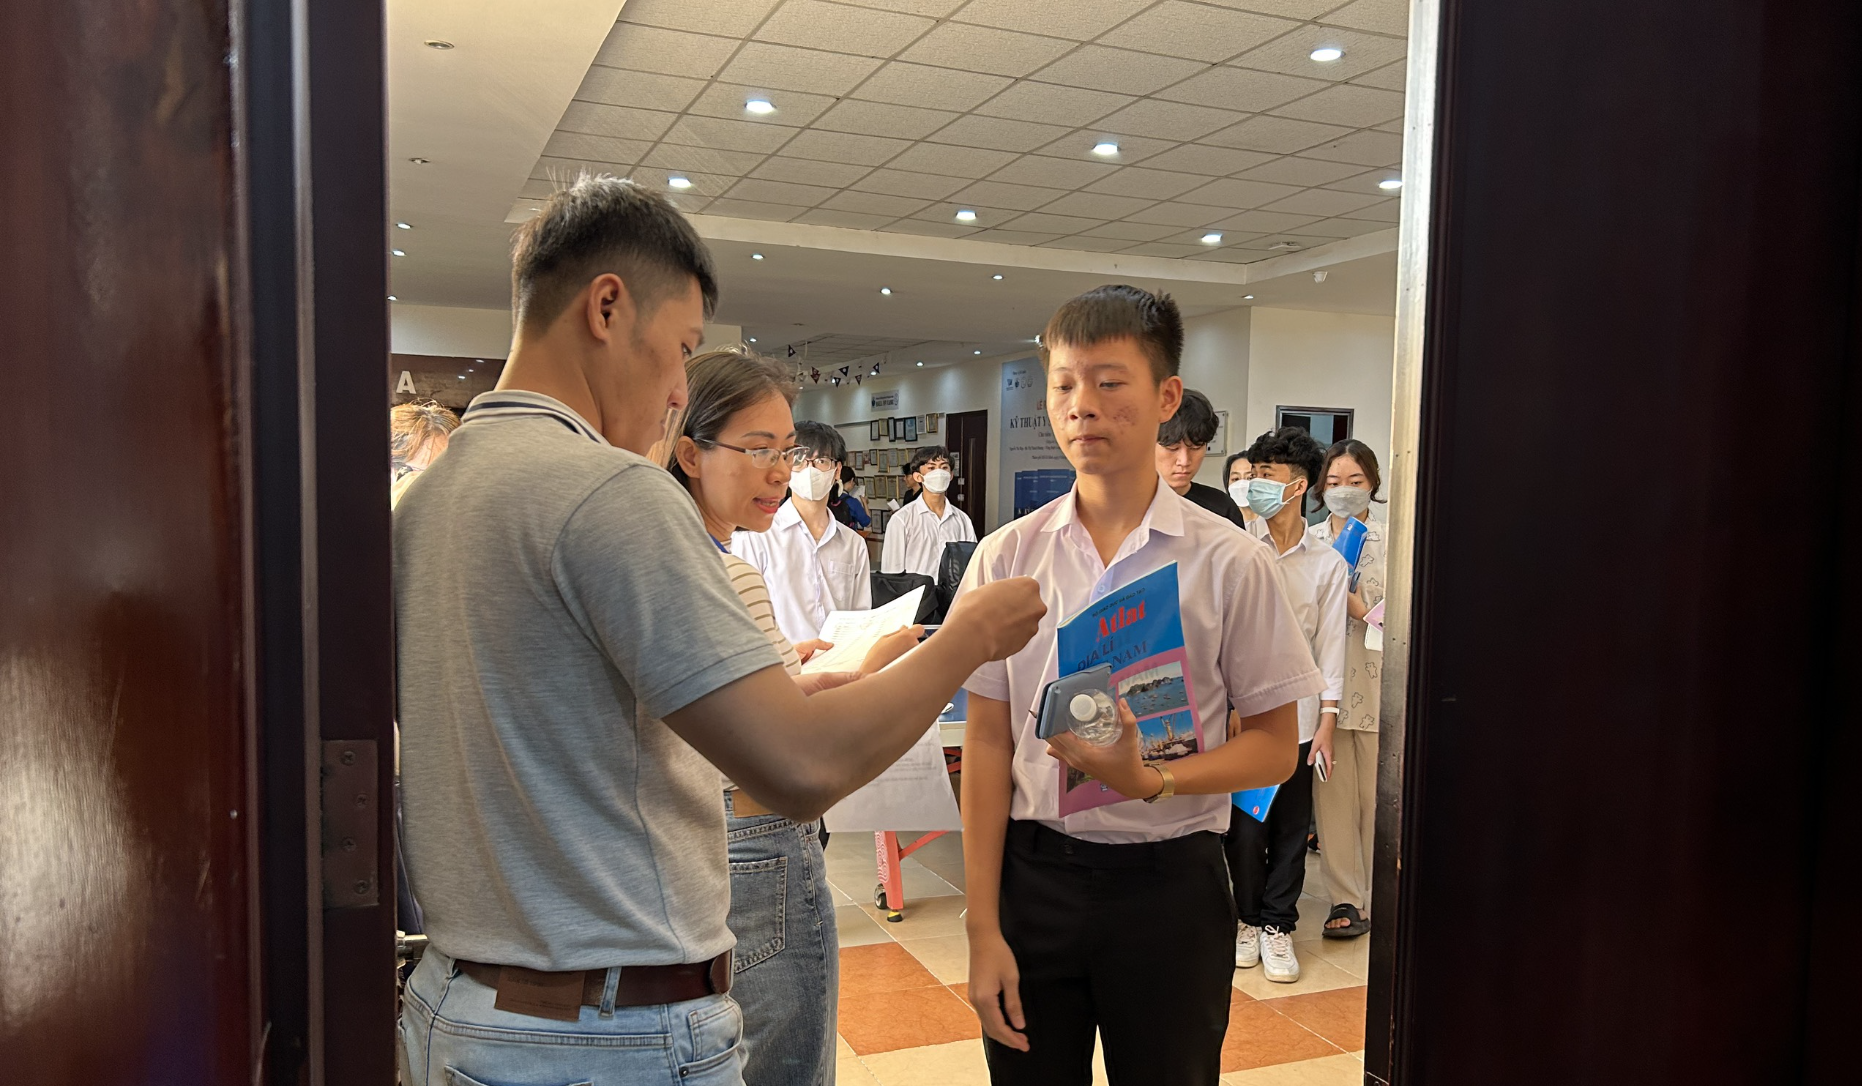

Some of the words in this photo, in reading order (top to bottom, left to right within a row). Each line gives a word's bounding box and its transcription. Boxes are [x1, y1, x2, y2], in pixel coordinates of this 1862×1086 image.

[396, 370, 417, 394] A
[1096, 599, 1147, 643] Atlat
[1111, 640, 1148, 668] NAM
